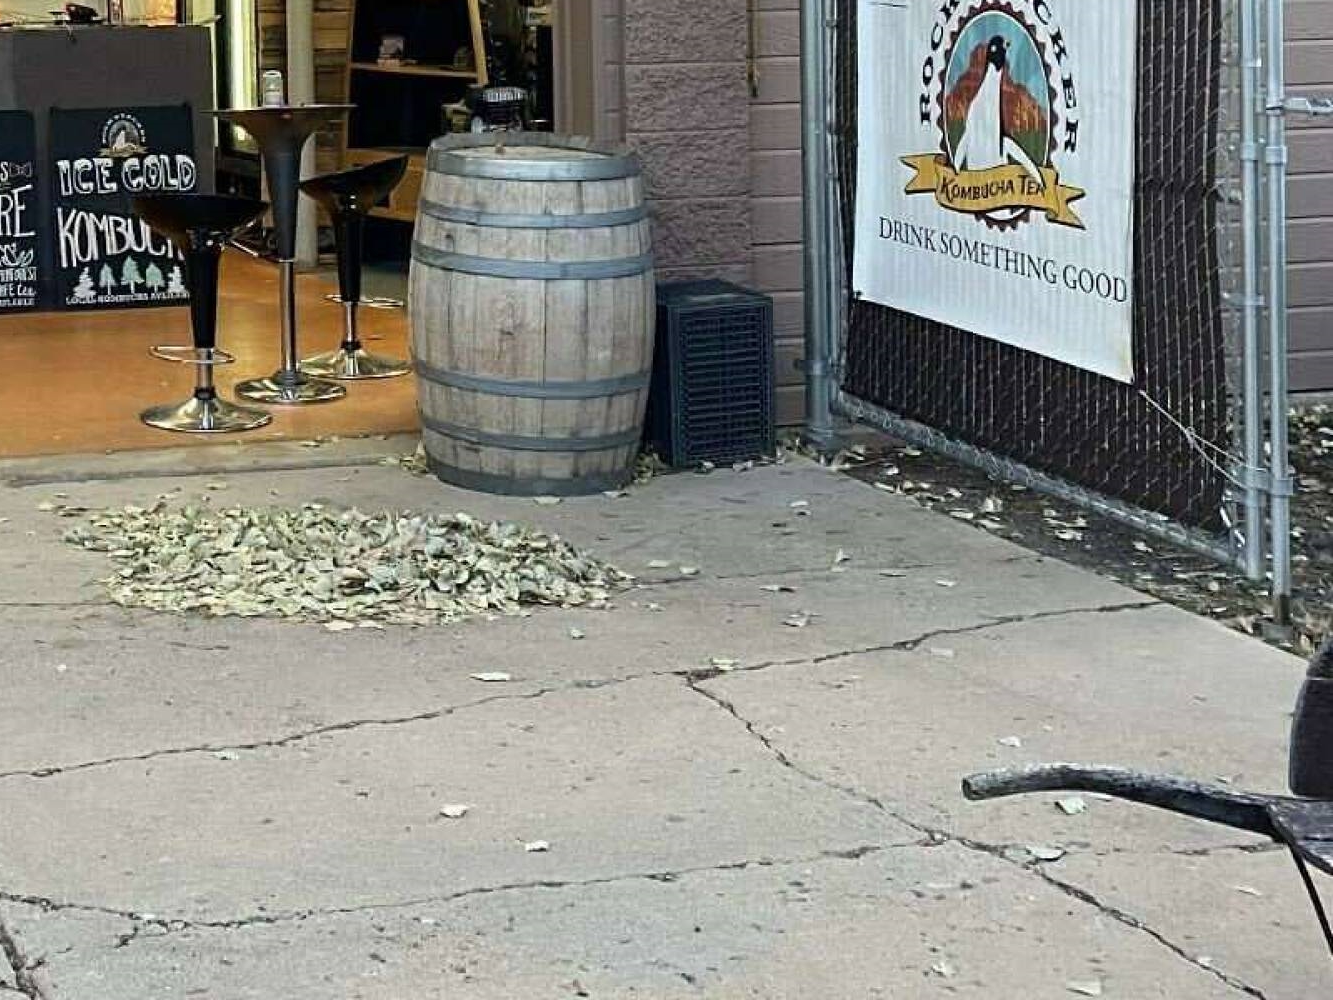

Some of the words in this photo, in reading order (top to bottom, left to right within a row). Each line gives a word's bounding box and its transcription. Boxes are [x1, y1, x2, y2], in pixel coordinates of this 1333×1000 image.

[57, 158, 118, 196] ICE
[122, 154, 196, 192] COLD
[940, 175, 1015, 203] KOMBUCHA
[56, 207, 185, 268] KOMBUC
[879, 216, 939, 252] DRINK
[940, 232, 1058, 285] SOMETHING
[1062, 264, 1127, 302] GOOD
